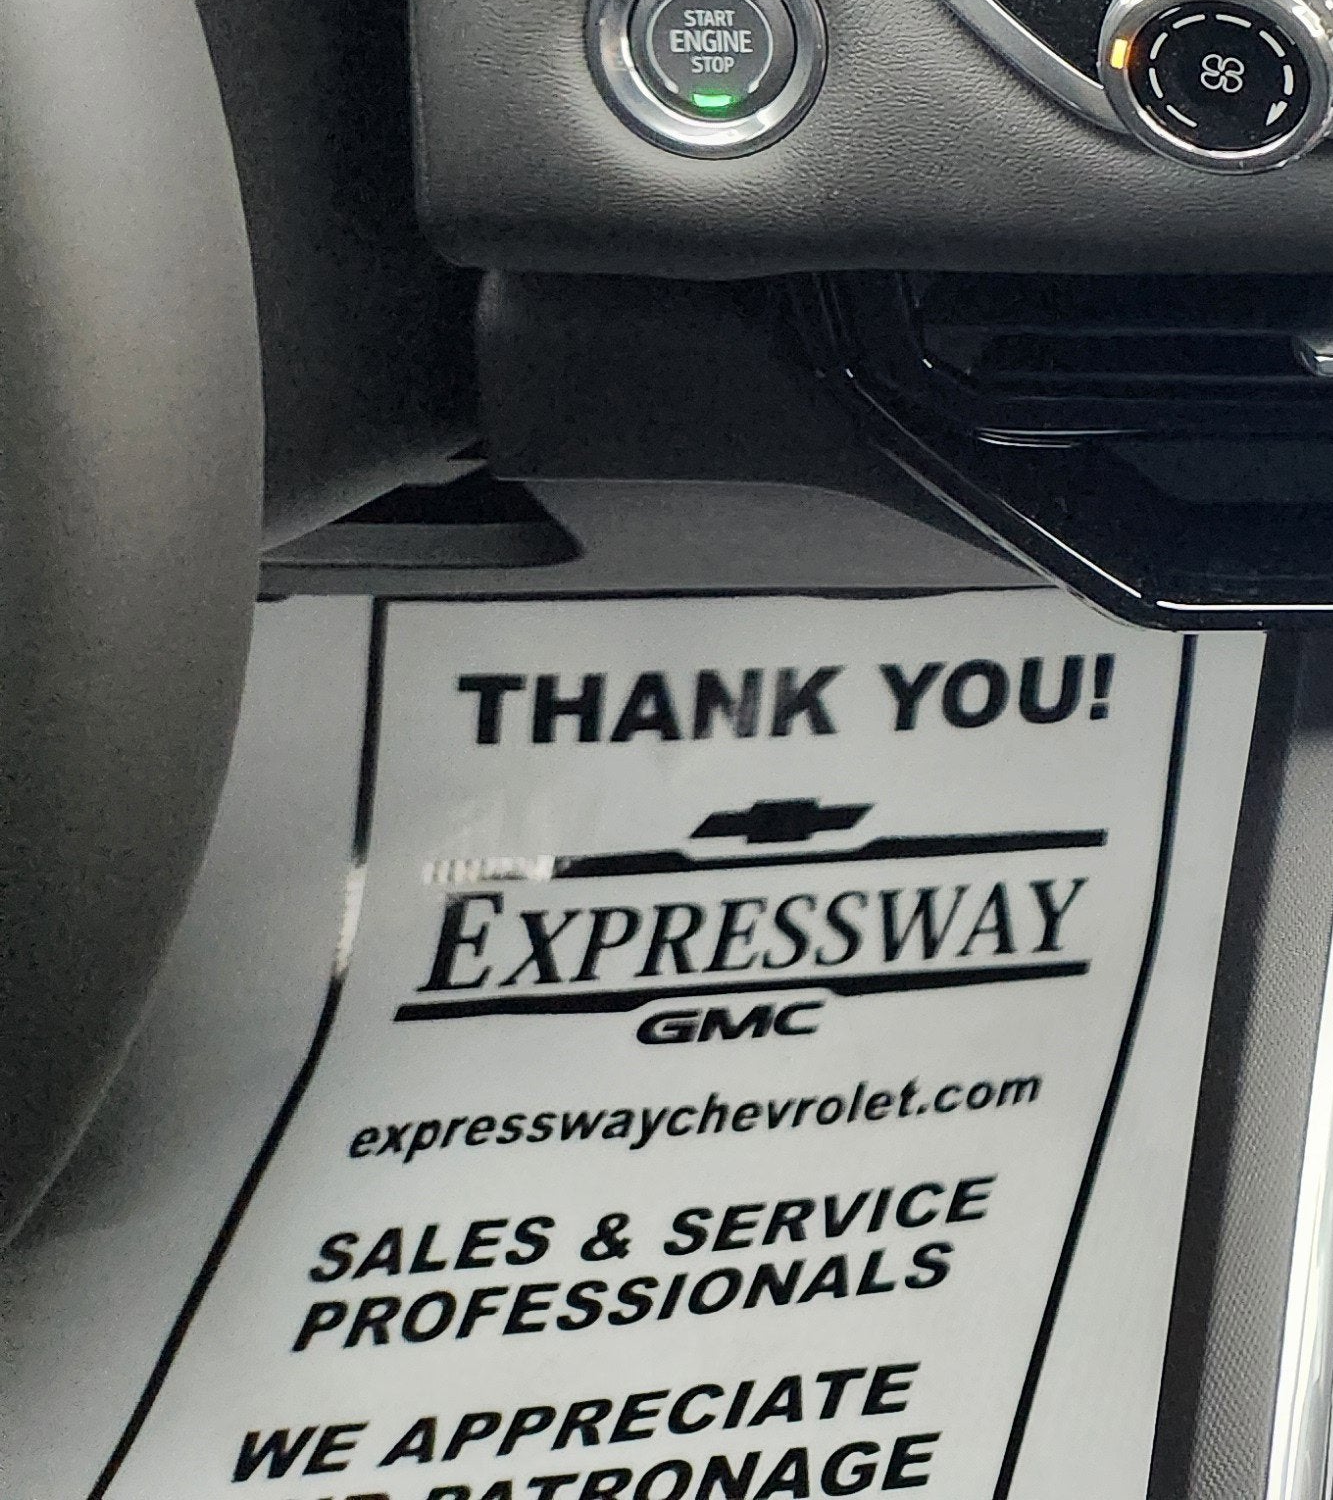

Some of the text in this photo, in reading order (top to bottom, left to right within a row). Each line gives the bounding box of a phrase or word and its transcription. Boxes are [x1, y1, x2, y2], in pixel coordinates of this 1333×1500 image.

[669, 29, 753, 53] ENGINE
[684, 10, 735, 28] START
[691, 56, 735, 74] STOP
[457, 653, 1116, 747] THANK YOU!
[415, 876, 1090, 994] EXPRESSWAY
[635, 999, 827, 1047] GMC
[347, 1072, 1043, 1165] expresswaychevrolet.com
[307, 1175, 998, 1285] SALES & SERVICE
[289, 1241, 956, 1354] PROFESSIONALS
[231, 1361, 923, 1483] WE APPRECIATE
